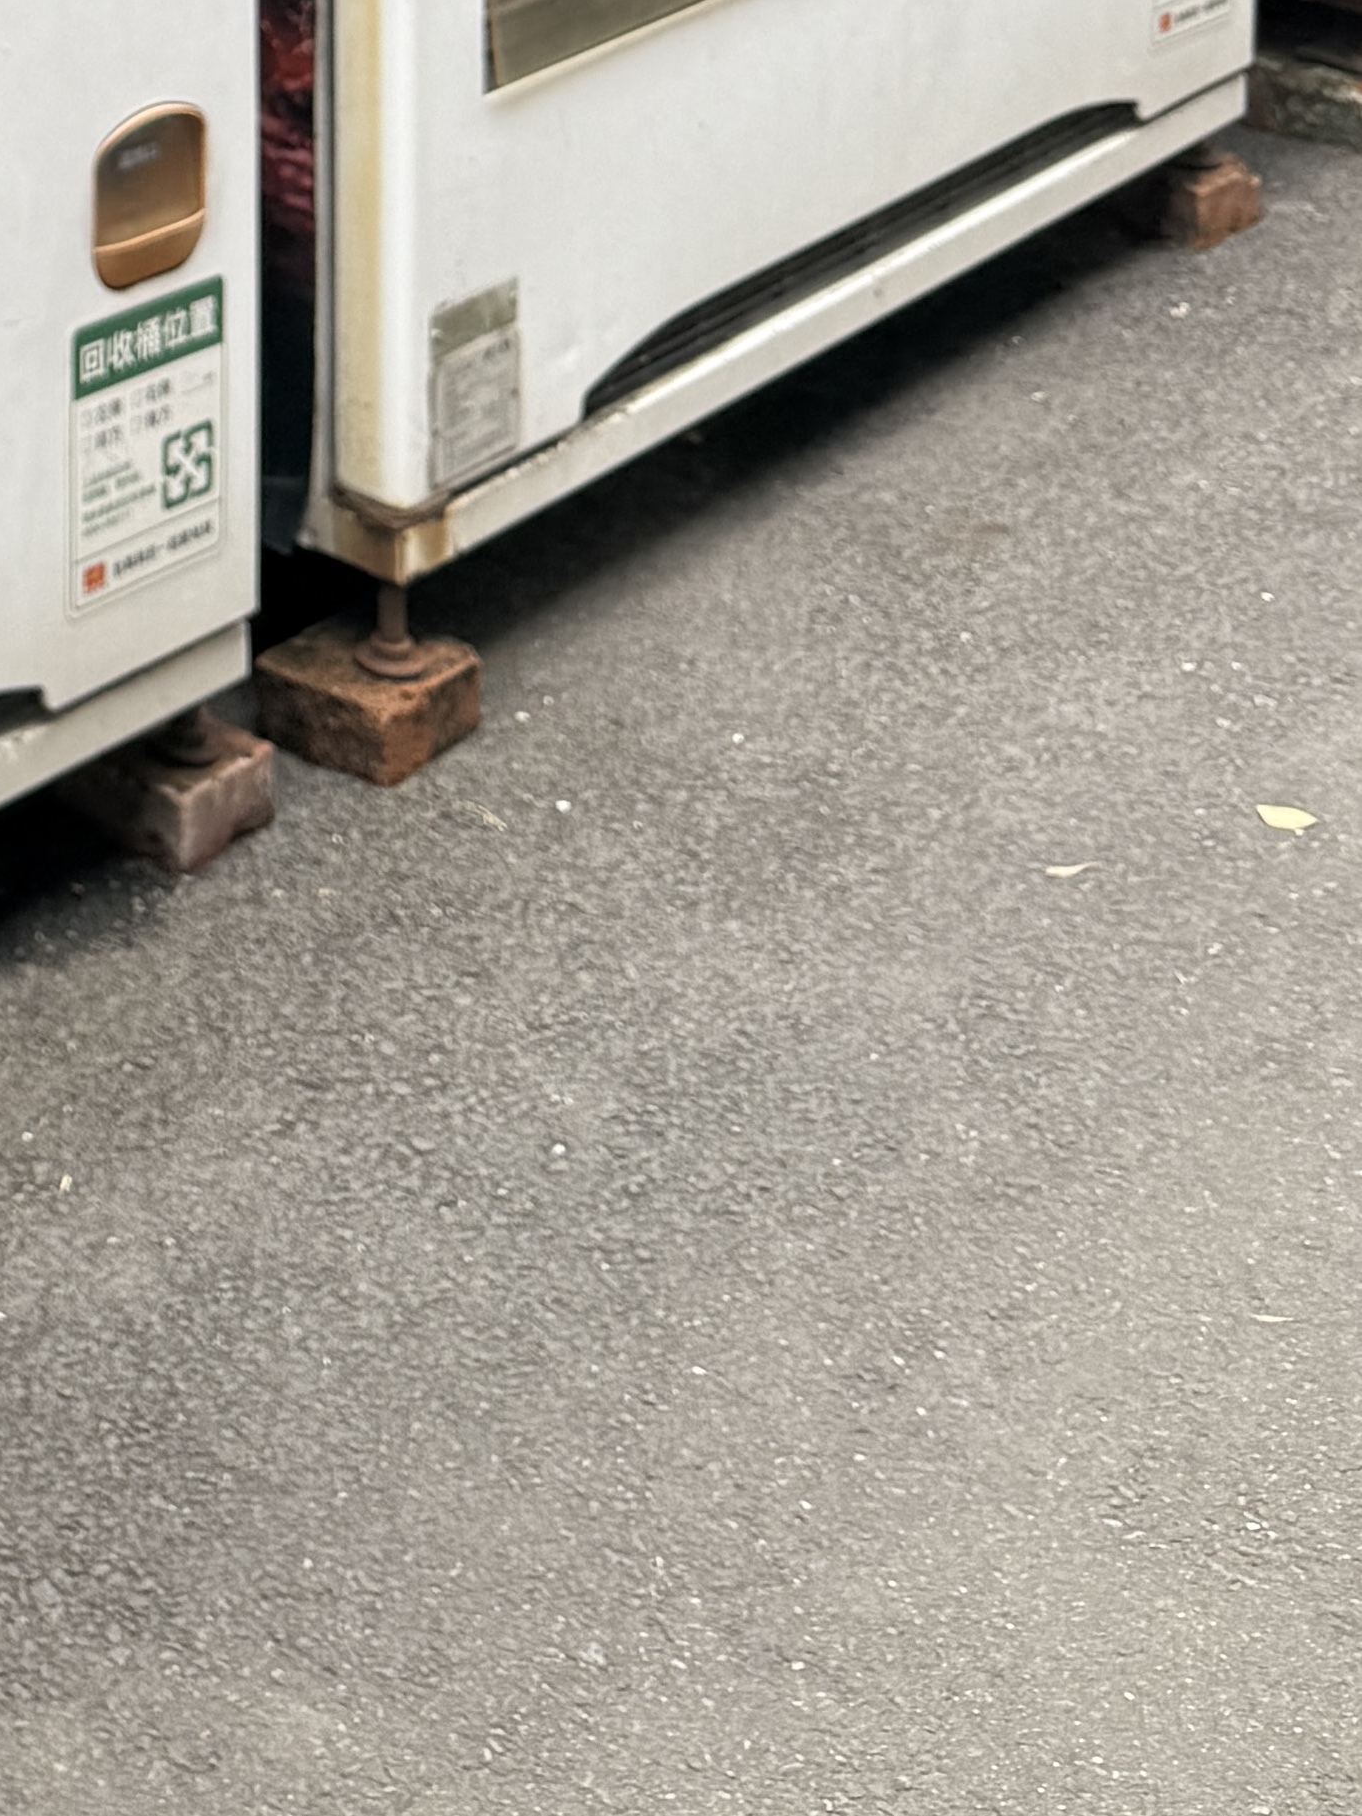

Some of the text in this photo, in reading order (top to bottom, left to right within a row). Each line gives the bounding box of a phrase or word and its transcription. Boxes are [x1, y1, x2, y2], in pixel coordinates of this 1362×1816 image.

[78, 293, 219, 385] 回收桶位置
